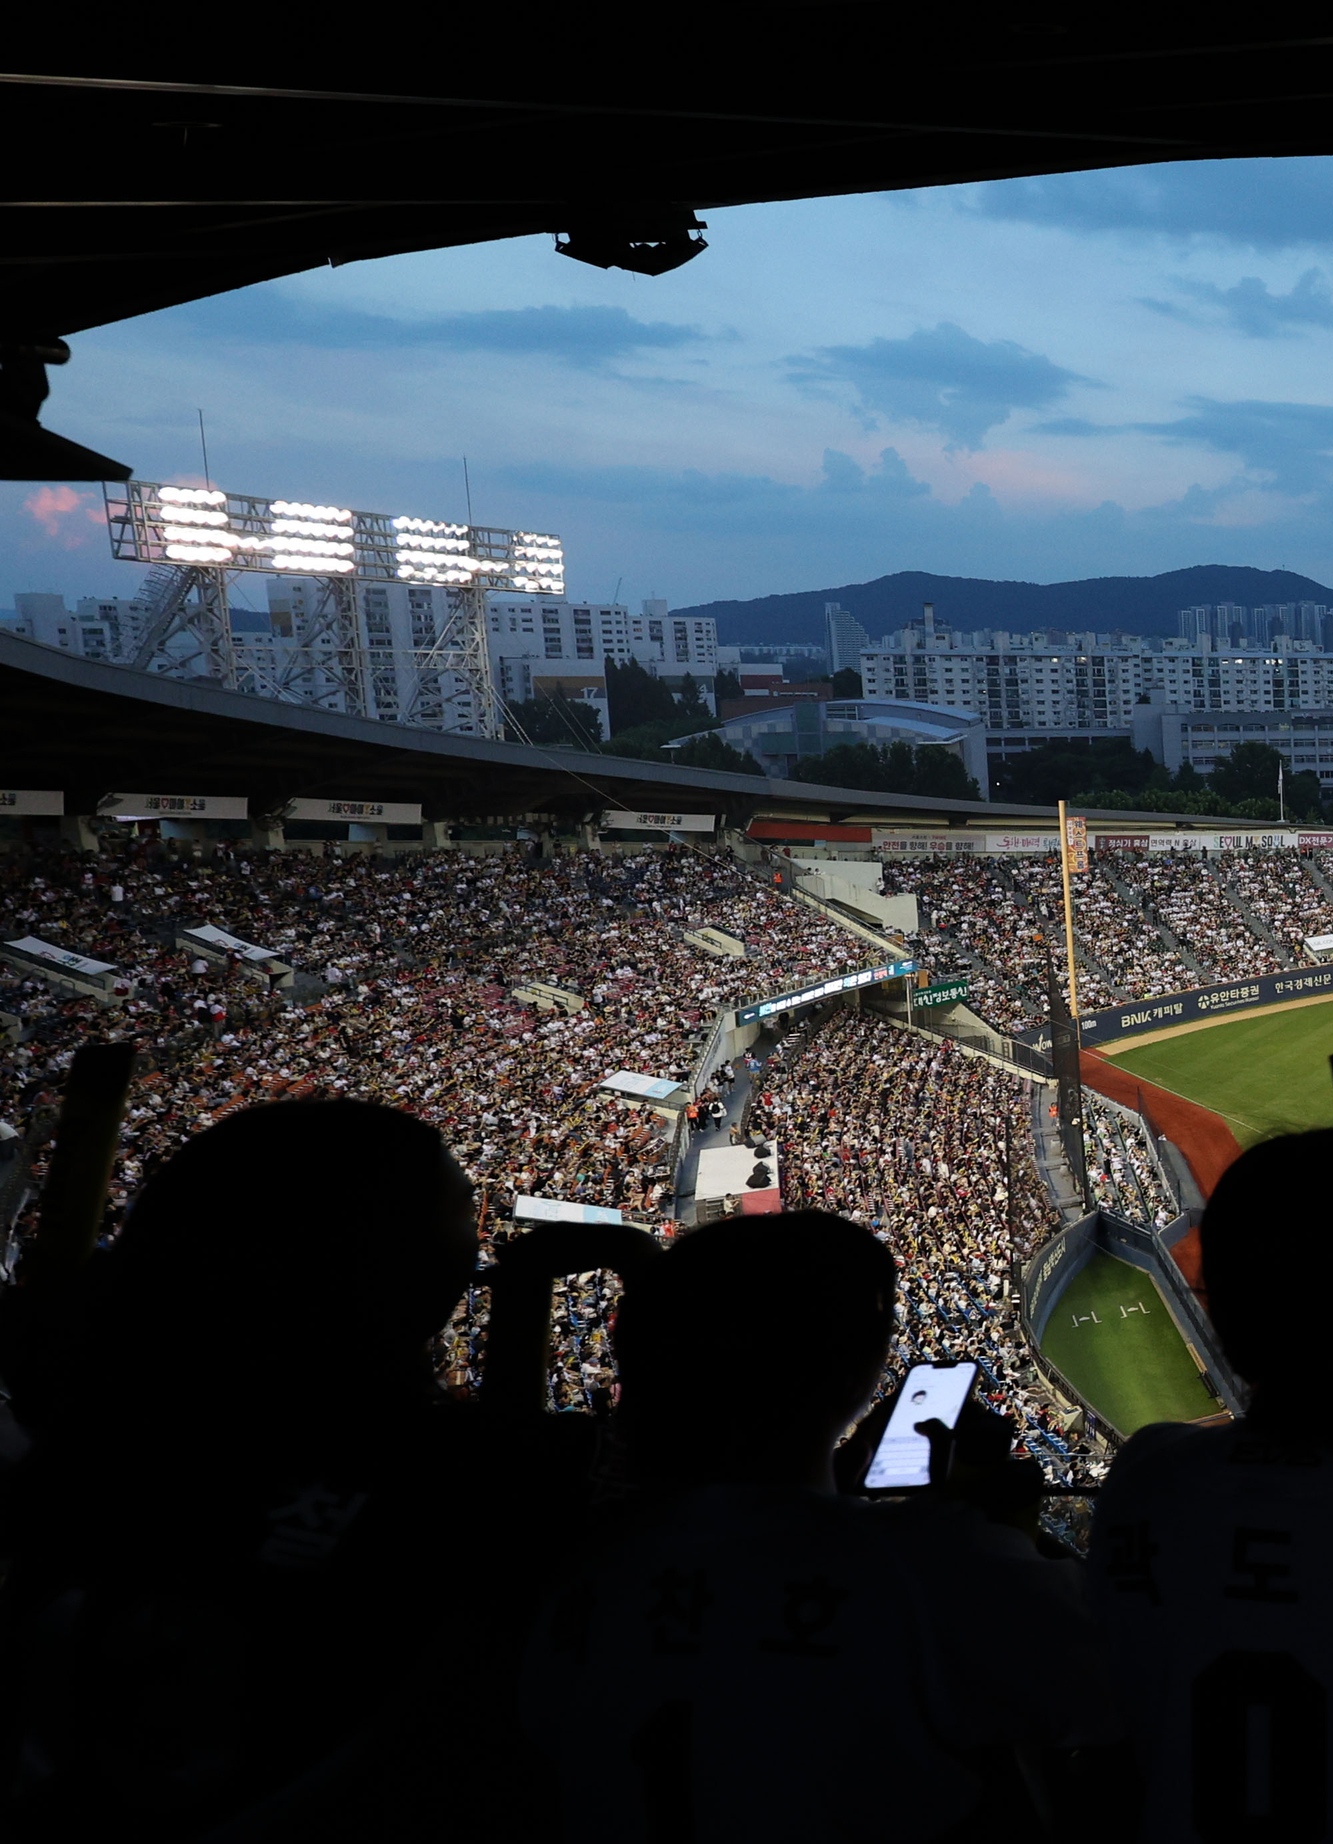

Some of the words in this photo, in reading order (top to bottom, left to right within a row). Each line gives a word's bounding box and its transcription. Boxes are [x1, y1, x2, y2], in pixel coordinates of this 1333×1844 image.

[1275, 973, 1332, 994] 한국경제신문
[913, 986, 968, 1008] 대신정보통신
[1210, 985, 1260, 1003] 유안타증권
[1081, 1019, 1097, 1030] 100m
[1121, 1010, 1152, 1028] BNK
